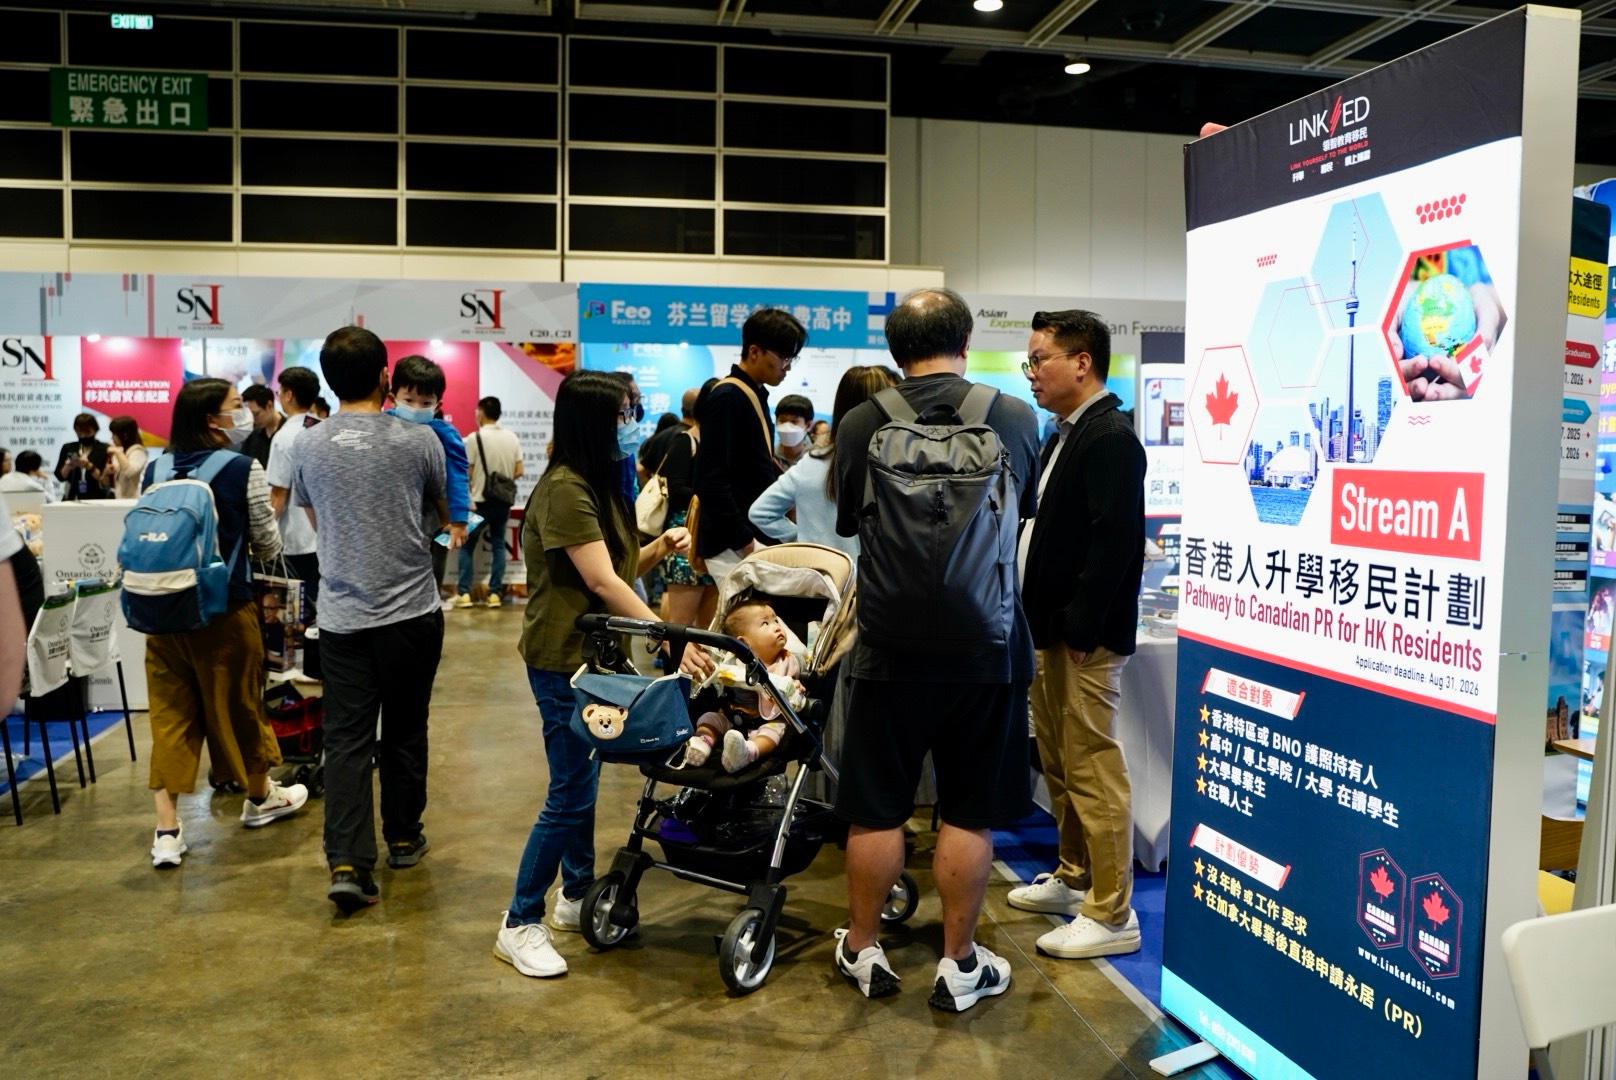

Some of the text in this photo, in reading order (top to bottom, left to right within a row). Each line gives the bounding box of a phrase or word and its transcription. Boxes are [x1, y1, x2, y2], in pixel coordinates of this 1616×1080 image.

[67, 73, 193, 95] EMERGENCY EXIT
[69, 95, 191, 126] 緊急出口
[1338, 146, 1348, 156] THE
[1348, 140, 1369, 152] WORLD
[611, 299, 652, 319] Feo
[976, 308, 1008, 319] Asian
[1570, 372, 1584, 386] 2026
[1340, 482, 1471, 542] Stream A
[138, 532, 169, 542] FILA
[56, 569, 92, 578] Ontario
[1185, 536, 1486, 631] 香港人升學移民計劃
[1185, 580, 1482, 672] Pathway to Canadian PR for HK Residents
[1355, 655, 1392, 674] Application
[1429, 673, 1444, 690] Aug
[1459, 679, 1479, 697] 2026
[1226, 677, 1273, 708] 適合對象
[1211, 708, 1379, 790] 香港特區或 BNO 護照持有人
[1207, 757, 1266, 798] 大學畢業生
[1209, 733, 1233, 757] 高中
[1242, 746, 1293, 784] 專上學院
[1304, 771, 1333, 799] 大學
[1336, 784, 1399, 829] 在讀學生
[1207, 780, 1254, 817] 在職人士
[1366, 902, 1396, 927] CANADA
[1418, 929, 1451, 956] CANADA
